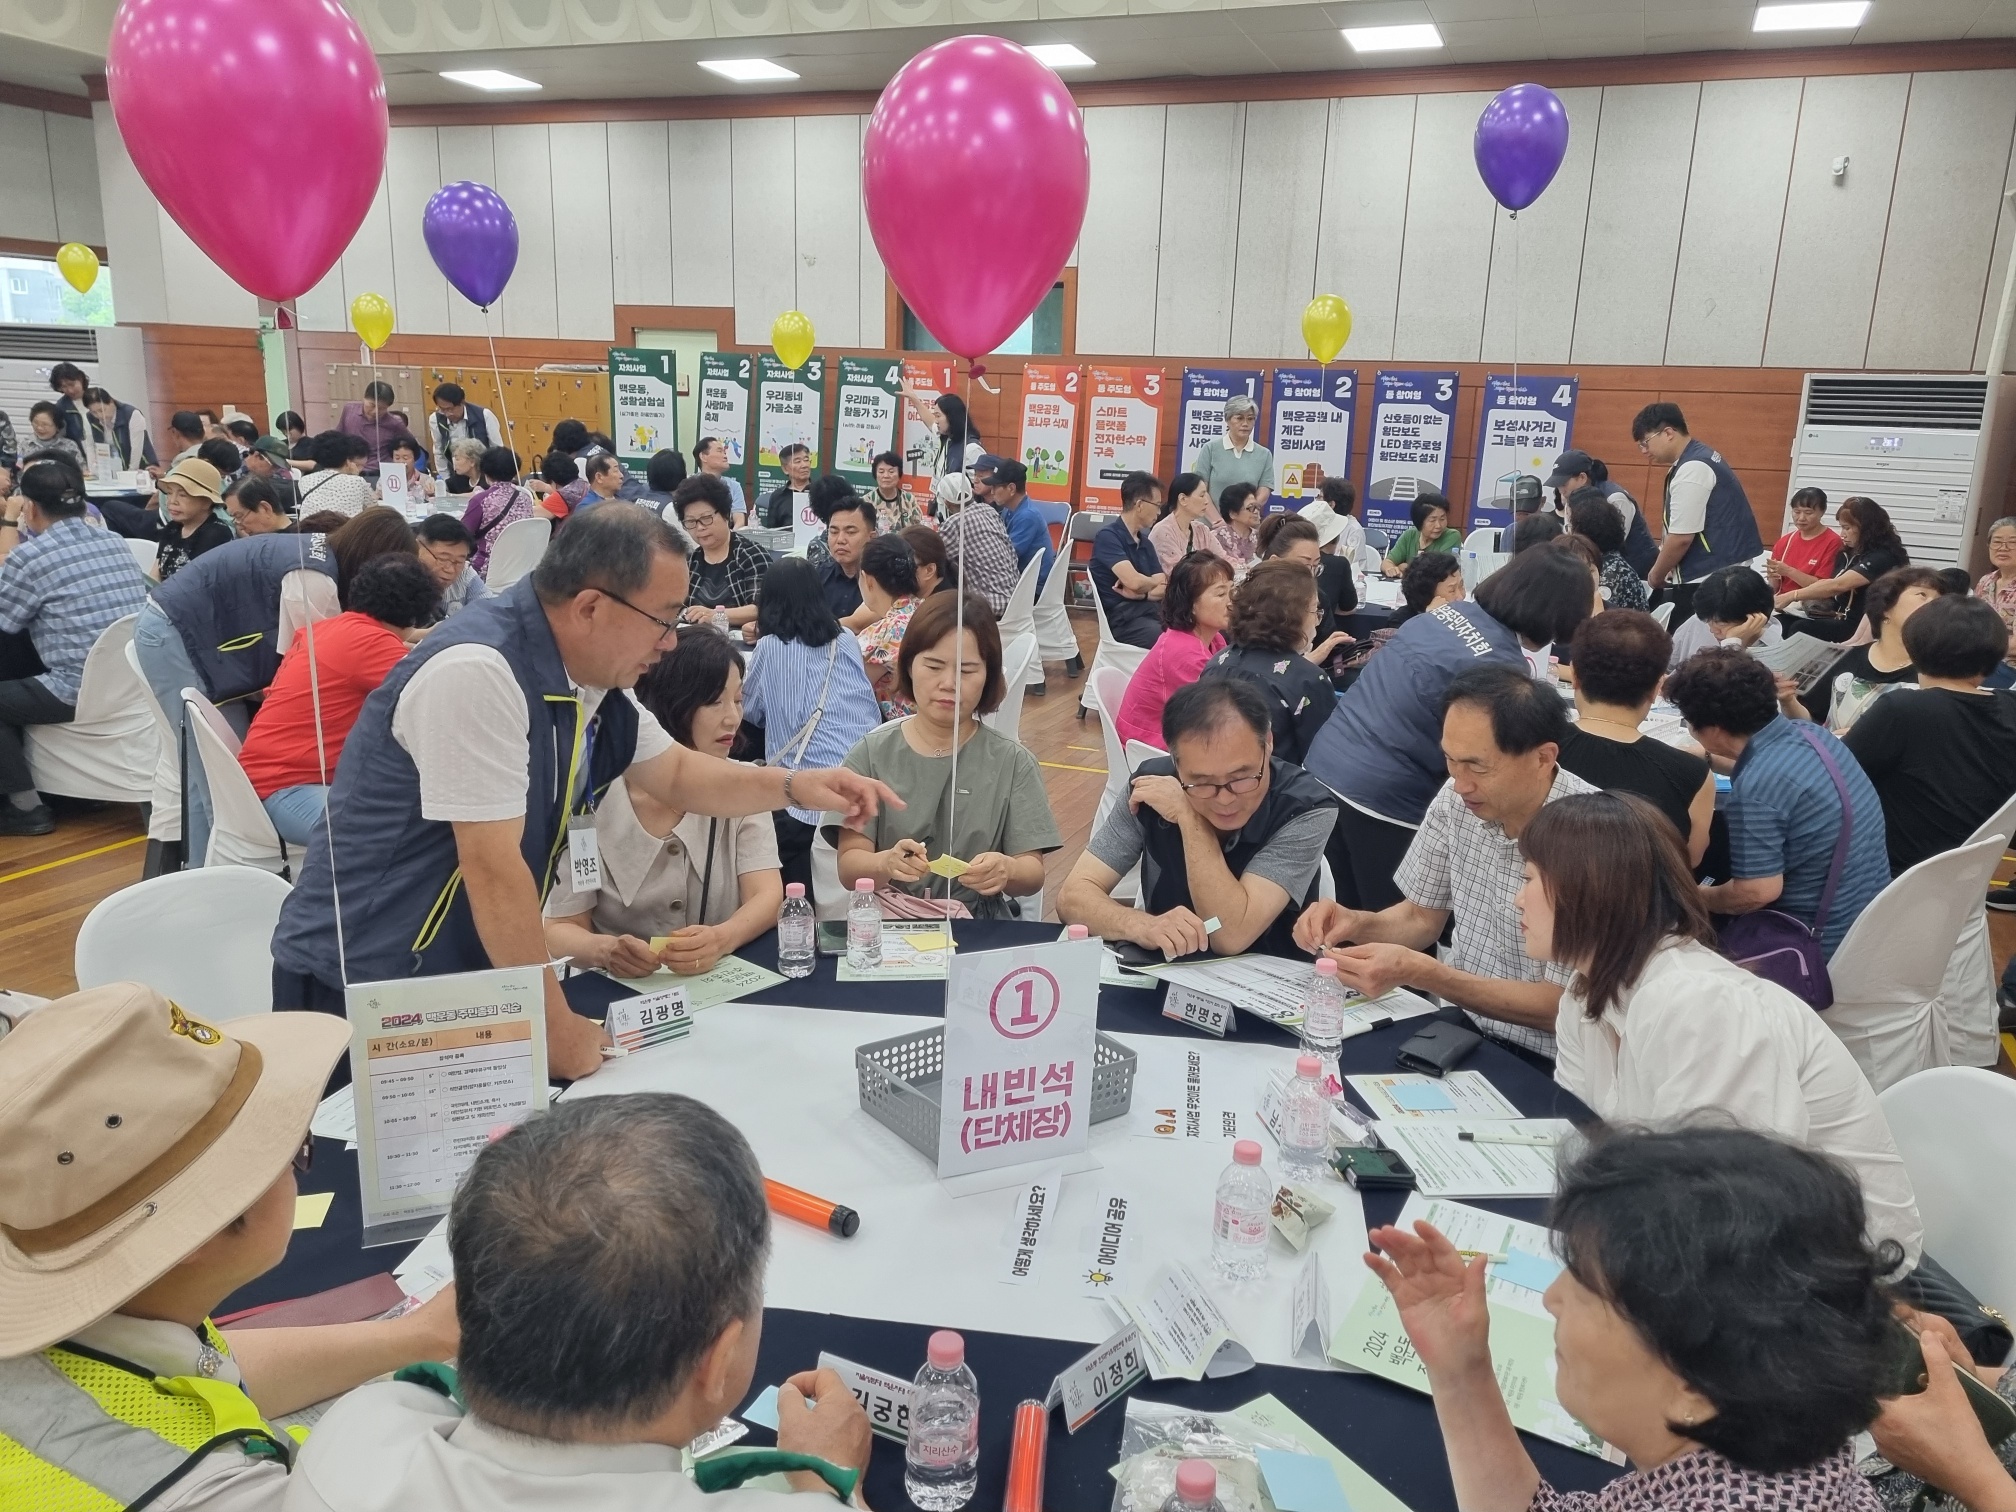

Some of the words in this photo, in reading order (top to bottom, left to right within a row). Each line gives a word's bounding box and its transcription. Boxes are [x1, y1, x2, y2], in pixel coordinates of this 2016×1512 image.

[618, 363, 647, 373] 자치사업
[661, 355, 669, 374] 1
[739, 359, 750, 378] 2
[807, 361, 821, 381] 3
[706, 368, 729, 377] 자치사업
[766, 370, 795, 379] 자치사업
[847, 374, 874, 383] 자치사업
[885, 366, 899, 385] 4
[943, 368, 950, 388] 1
[1037, 382, 1056, 392] 주도형
[1065, 372, 1078, 392] 2
[1144, 374, 1160, 395] 3
[1245, 378, 1256, 398] 1
[1335, 377, 1352, 398] 2
[619, 384, 649, 395] 백운동,
[706, 388, 727, 399] 백운동
[766, 390, 803, 401] 우리동네
[1107, 384, 1131, 394] 주도형
[1193, 388, 1201, 396] 동
[1203, 388, 1229, 398] 참여형
[1283, 388, 1292, 397] 동
[1295, 388, 1321, 398] 참여형
[1386, 390, 1394, 399] 동
[1396, 390, 1422, 400] 참여형
[1435, 379, 1453, 401] 3
[1552, 384, 1571, 407] 4
[619, 396, 665, 407] 생활실험실
[705, 400, 734, 411] 사랑마을
[844, 394, 880, 406] 우리마을
[1496, 395, 1506, 405] 동
[1508, 395, 1537, 406] 참여형
[765, 403, 803, 414] 가을소풍
[844, 406, 870, 418] 활동가
[872, 409, 888, 419] 3기
[1028, 404, 1060, 415] 백운공원
[1096, 407, 1127, 418] 스마트
[704, 413, 719, 422] 축제
[1191, 410, 1225, 422] 백운공
[1282, 410, 1327, 422] 백운공원
[1331, 411, 1343, 424] 내
[1383, 413, 1421, 425] 신호등이
[1422, 414, 1443, 425] 없는
[1028, 417, 1051, 428] 꽃나무
[1053, 418, 1069, 429] 식재
[1095, 420, 1127, 431] 플랫폼
[1190, 424, 1223, 435] 진입로
[1493, 419, 1556, 433] 보성사거리
[1281, 425, 1304, 436] 계단
[1382, 426, 1420, 437] 횡단보도
[1094, 433, 1147, 446] 전자현수막
[1280, 439, 1326, 451] 정비사업
[1380, 439, 1401, 449] LED
[1402, 439, 1442, 451] 활주로형
[1491, 434, 1530, 447] 그늘막
[1532, 435, 1557, 448] 설치
[1094, 447, 1115, 458] 구축
[1379, 451, 1418, 463] 횡단보도
[1419, 452, 1438, 464] 설치
[574, 857, 597, 877] 박영조
[735, 974, 766, 987] 2024
[381, 1012, 423, 1030] 2024
[425, 1009, 458, 1024] 백운동
[457, 1004, 498, 1021] 주민총회
[500, 1002, 522, 1015] 식순
[640, 1000, 685, 1026] 김광명
[1185, 1002, 1223, 1028] 한명호
[475, 1029, 493, 1039] 내용
[372, 1043, 381, 1052] 시
[386, 1036, 434, 1051] 간(소요/분)
[1187, 1051, 1200, 1084] 물어보세요?
[963, 1060, 1075, 1112] 내빈석
[1186, 1085, 1200, 1110] 무엇이든
[960, 1101, 1072, 1155] (단체장)
[1186, 1110, 1200, 1138] 자치사업
[1222, 1111, 1237, 1139] 기타의견
[1106, 1197, 1128, 1221] 공유
[1020, 1185, 1046, 1247] 생각하세요?
[1097, 1222, 1124, 1266] 아이디어
[1011, 1248, 1034, 1277] 어떻게
[1362, 1330, 1390, 1358] 2024
[1093, 1347, 1140, 1398] 이정희
[923, 1444, 959, 1457] 지리산수
